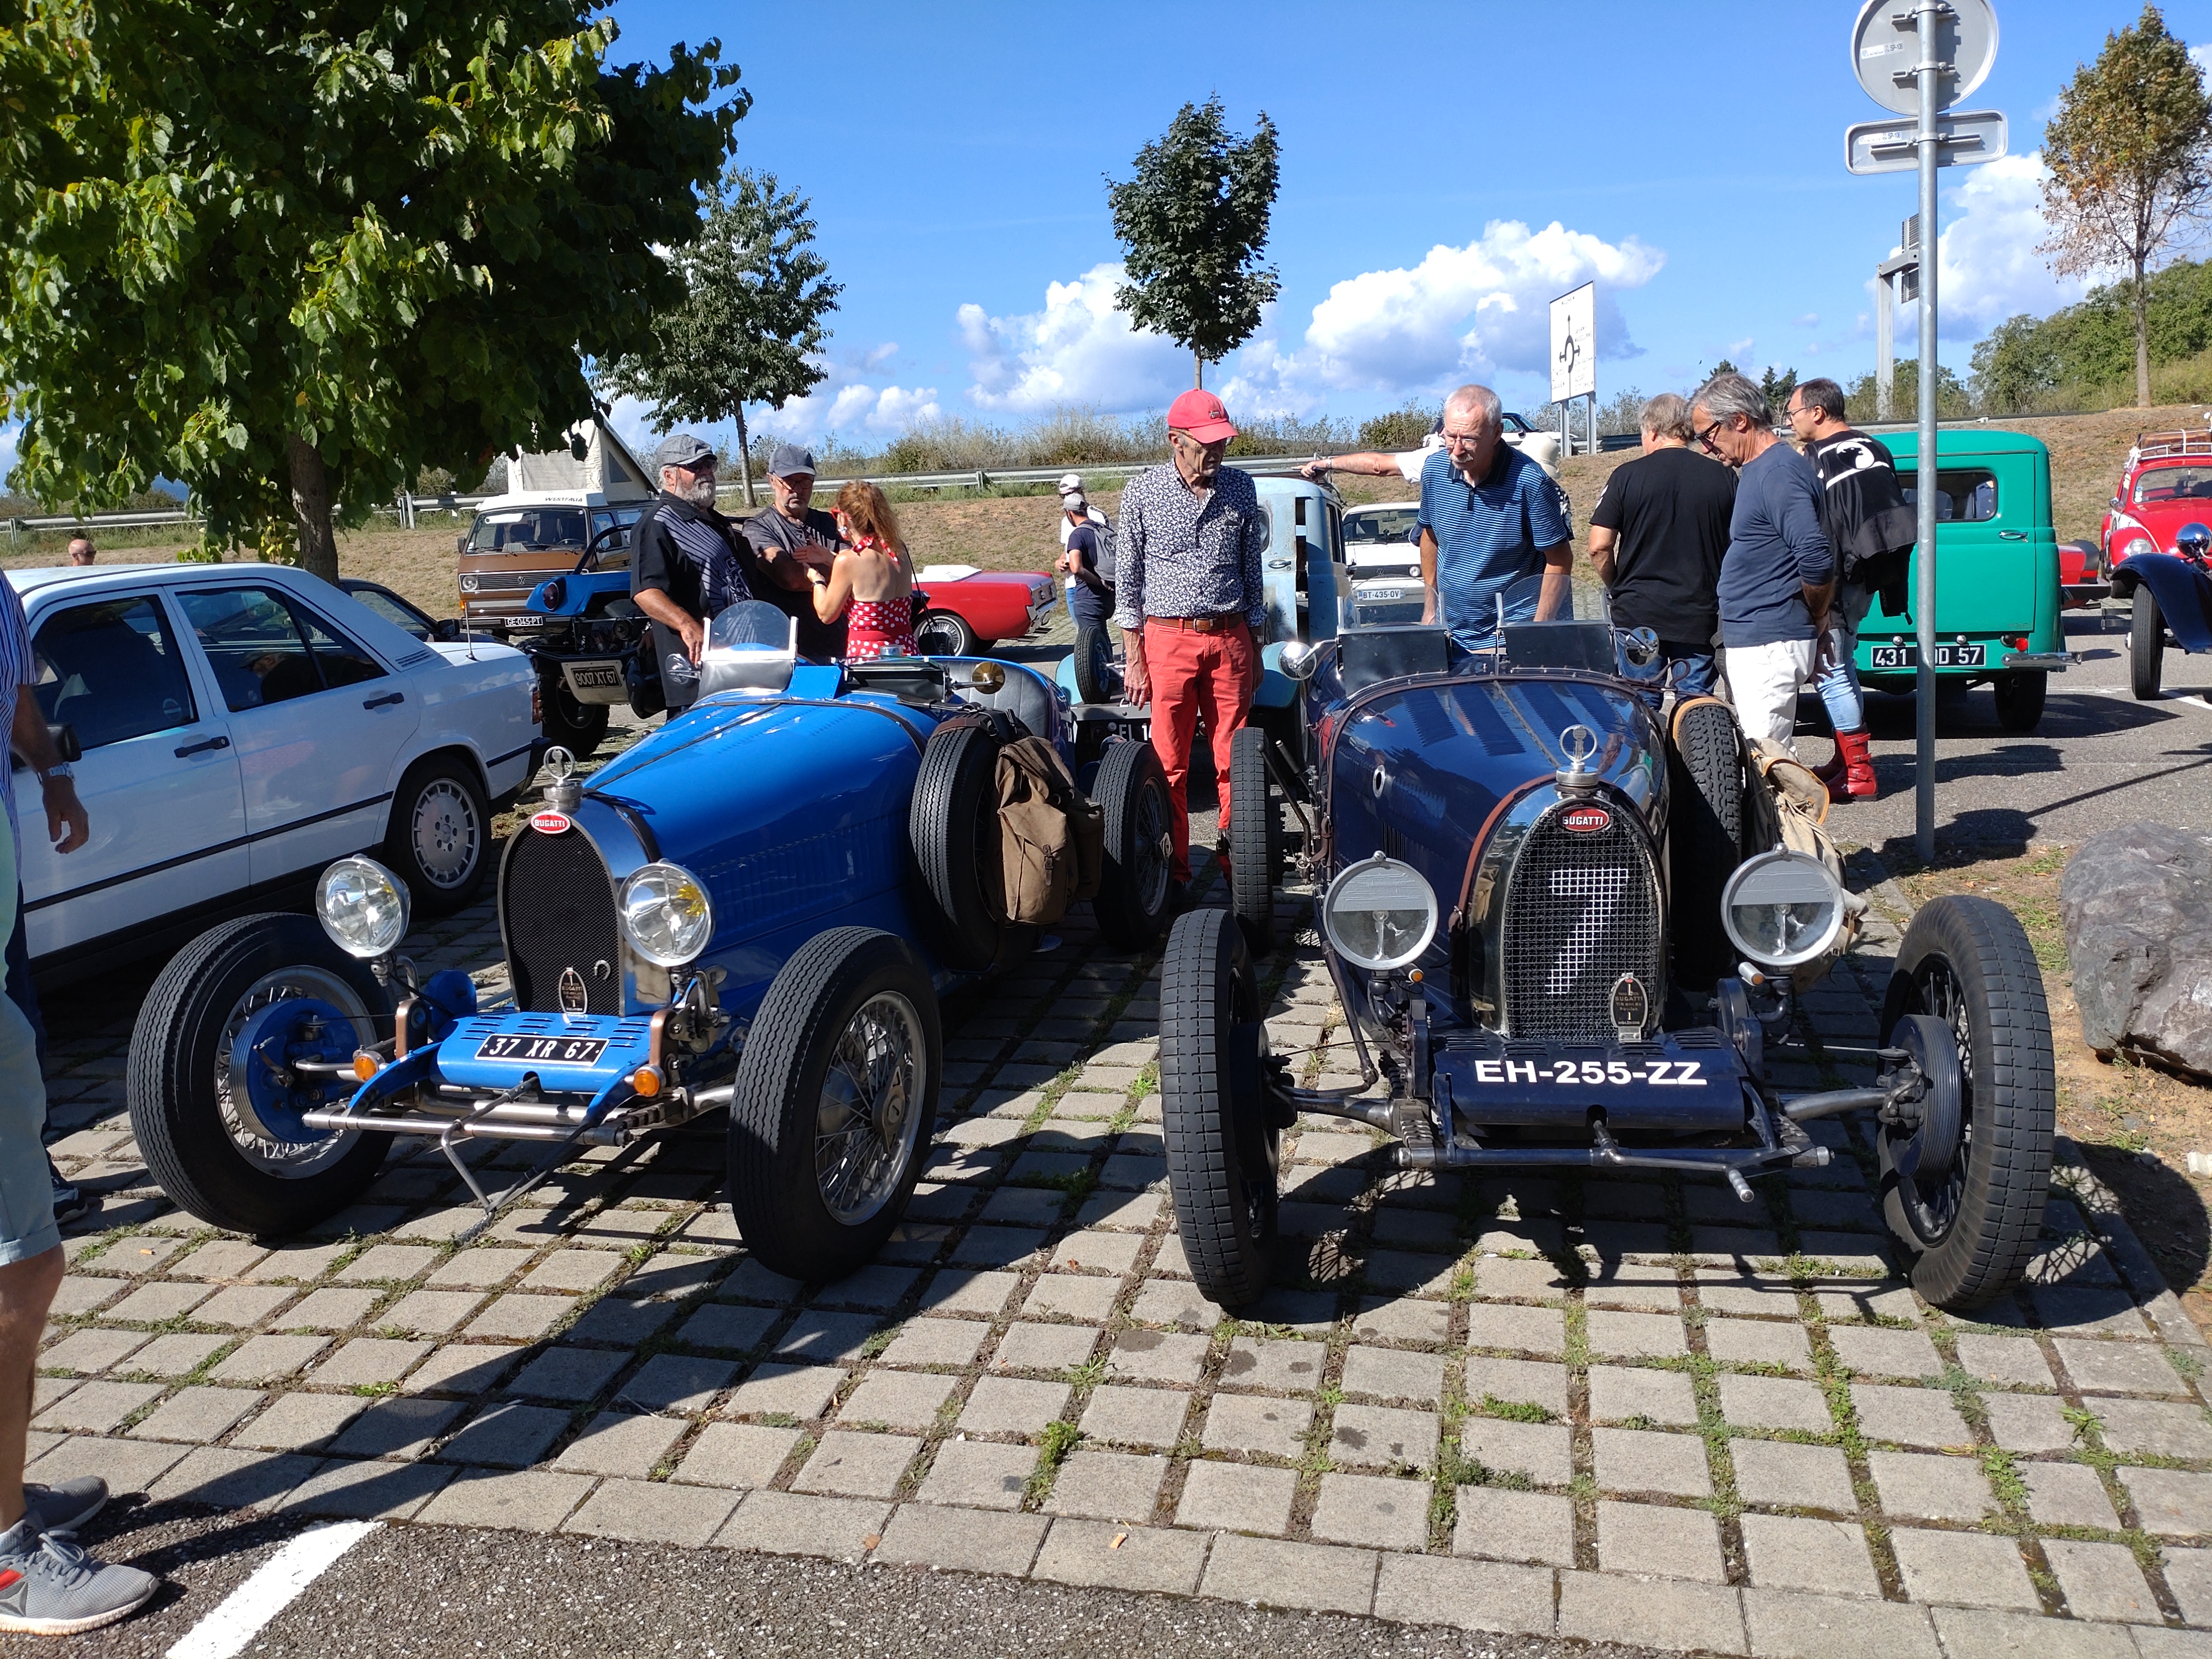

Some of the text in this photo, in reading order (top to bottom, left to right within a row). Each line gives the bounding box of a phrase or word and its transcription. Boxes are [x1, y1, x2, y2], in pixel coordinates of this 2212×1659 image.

[1875, 647, 1981, 666] 431 D 57
[575, 671, 616, 685] 9007 XT 67
[1141, 724, 1151, 741] 1
[1562, 816, 1603, 825] BUGATTI
[489, 1038, 596, 1060] 37 XR 67
[1474, 1060, 1708, 1085] EH-255-ZZ
